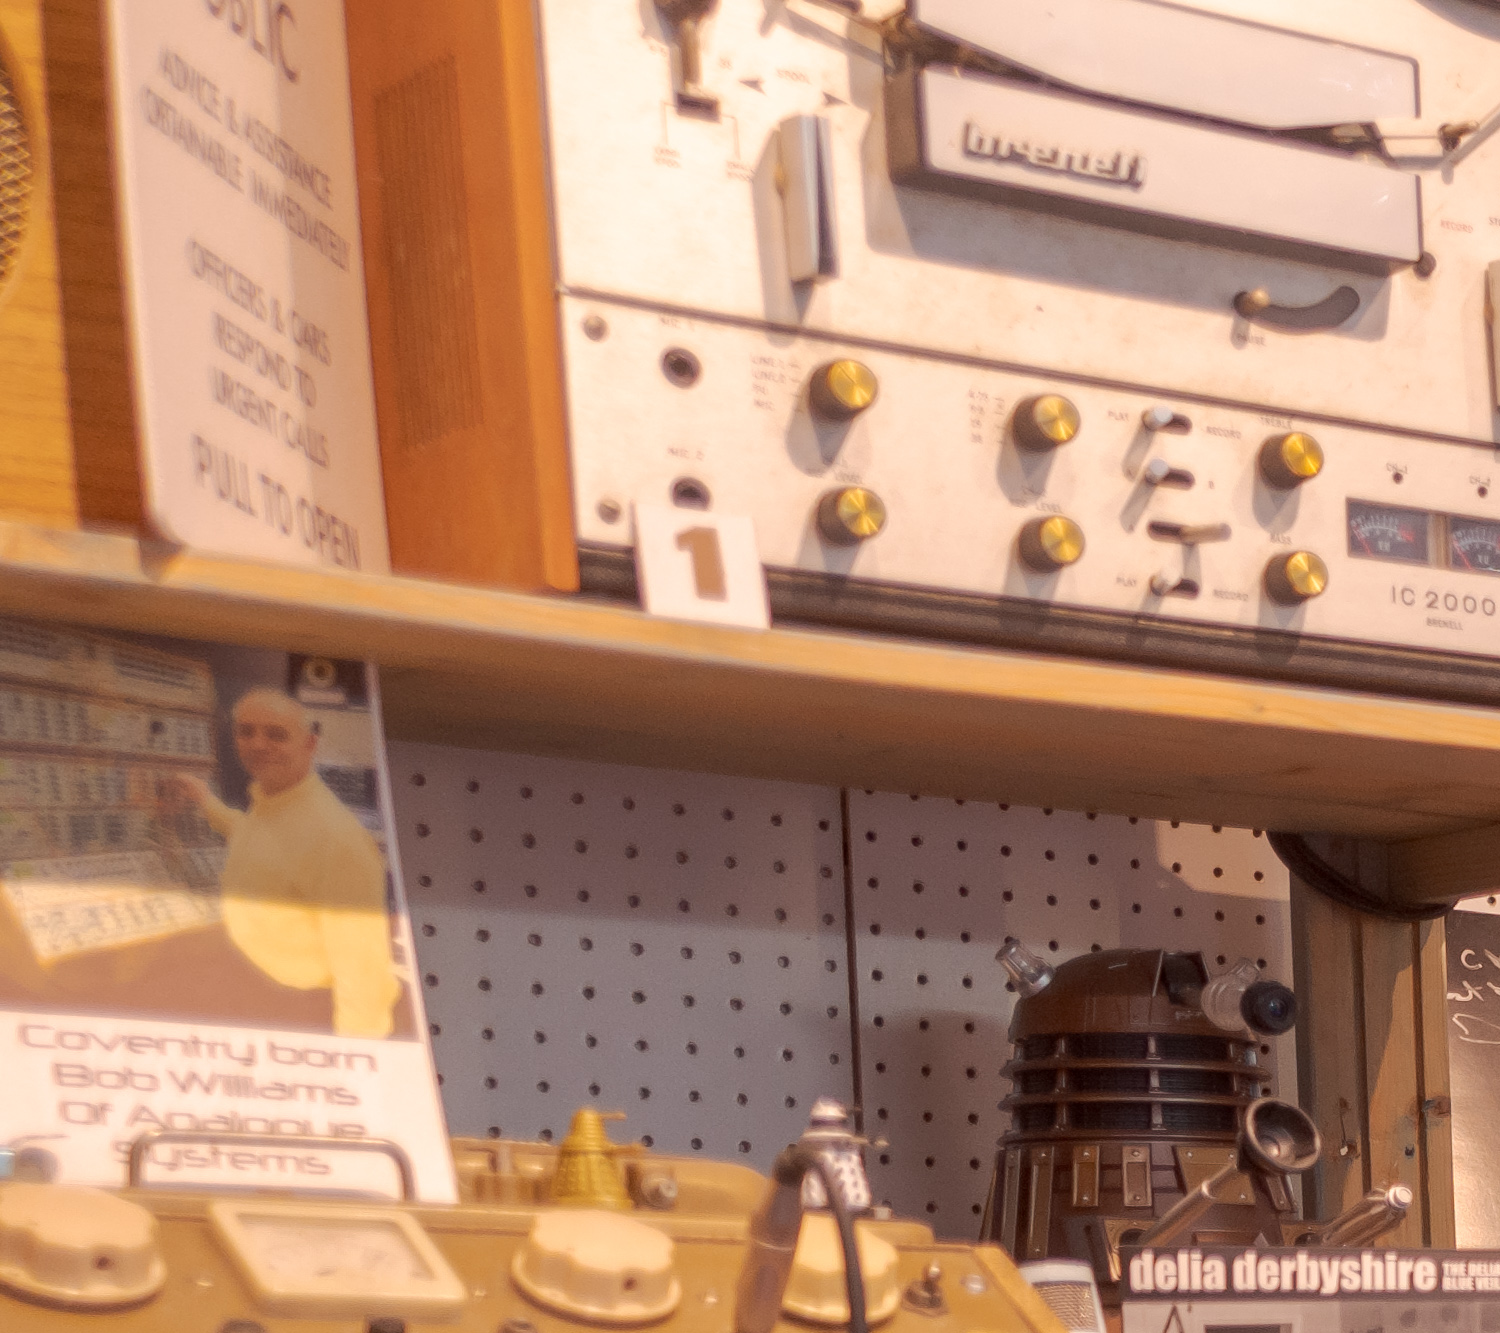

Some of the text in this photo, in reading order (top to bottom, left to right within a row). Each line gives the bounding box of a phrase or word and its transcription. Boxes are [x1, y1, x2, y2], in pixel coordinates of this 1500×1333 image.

[144, 86, 245, 193] OBTAINABLE
[212, 366, 330, 469] URGENT CALLS
[193, 433, 362, 570] PULL TO OPEN
[675, 526, 730, 602] 1
[1391, 585, 1499, 618] IC 2000
[18, 1023, 378, 1073] Coventry born
[52, 1063, 159, 1092] Bob
[1128, 1249, 1438, 1295] delia derbyshire
